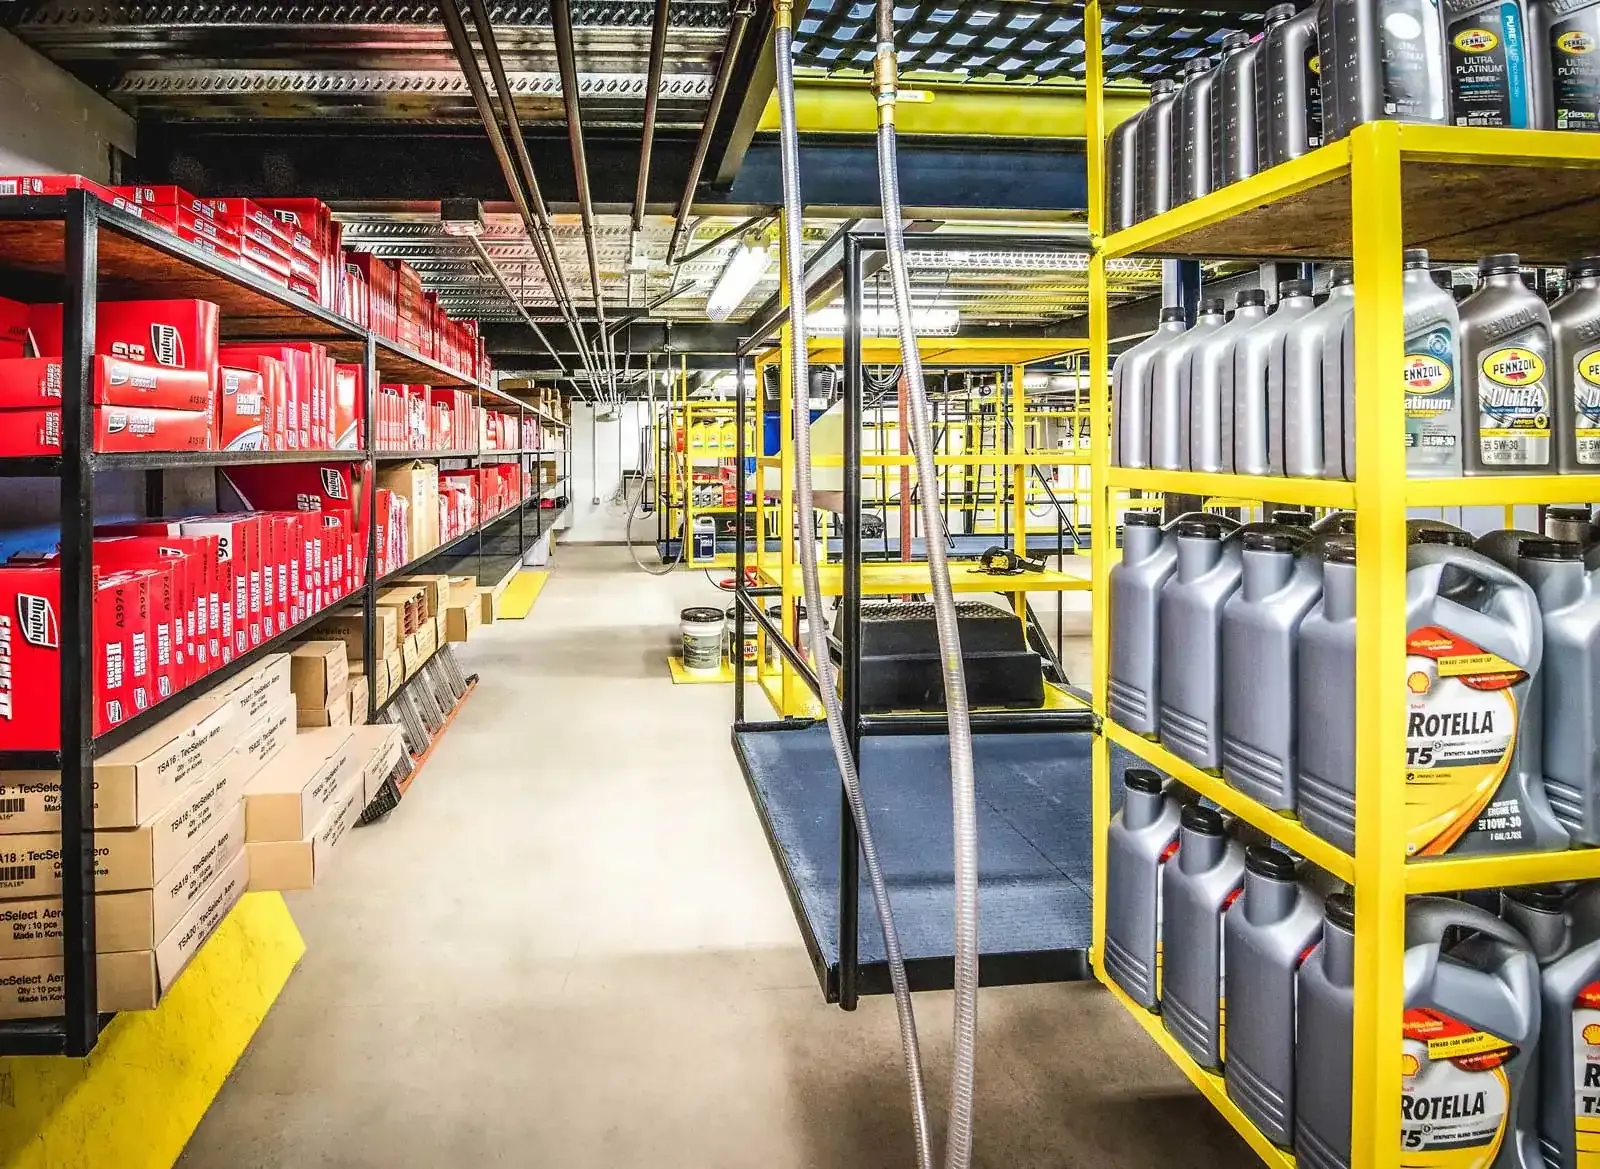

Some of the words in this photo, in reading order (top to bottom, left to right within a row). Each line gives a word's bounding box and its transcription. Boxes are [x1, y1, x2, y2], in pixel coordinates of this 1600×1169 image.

[1462, 36, 1492, 46] PENNZOIL
[1464, 56, 1494, 64] ULTRA
[1456, 64, 1504, 74] PLATINUM
[161, 326, 174, 365] Mighty
[1404, 366, 1442, 380] ENNZOIL
[1493, 359, 1536, 374] PENNZOIL
[1405, 396, 1452, 410] atinum
[1491, 388, 1544, 406] ULTRA
[1431, 436, 1454, 446] 5W-30
[1494, 440, 1519, 450] 5W-30
[116, 588, 125, 628] A3974
[29, 597, 46, 644] Mighty
[106, 652, 116, 688] ENGINE
[114, 652, 122, 688] GUARD
[1407, 711, 1494, 738] ROTELLA
[157, 754, 177, 774] TSA16
[180, 734, 208, 758] TecSelect
[208, 726, 221, 740] Aero
[1406, 747, 1433, 764] T5
[18, 782, 63, 794] TecSelec
[44, 794, 58, 804] Qty
[170, 812, 188, 832] TSA18
[192, 788, 214, 814] TecSelect
[216, 778, 227, 790] Aero
[44, 804, 62, 812] Mad
[1488, 806, 1510, 816] ENGINE
[1510, 805, 1520, 814] OIL
[1486, 816, 1522, 830] 10W-30
[28, 850, 63, 860] TecSel
[93, 848, 110, 856] ero
[170, 876, 188, 898] TSA19
[192, 846, 216, 874] TecSelect
[217, 832, 229, 848] Aero
[178, 926, 196, 950] TSA20
[200, 894, 224, 922] TecSelect
[224, 879, 236, 896] Aero
[13, 923, 26, 932] Qty
[44, 922, 58, 930] pcs
[13, 932, 34, 940] Made
[44, 930, 62, 938] Kore
[47, 974, 64, 983] Aer
[18, 987, 31, 995] Qty
[48, 986, 62, 994] pcs
[1402, 1092, 1485, 1120] ROTELLA
